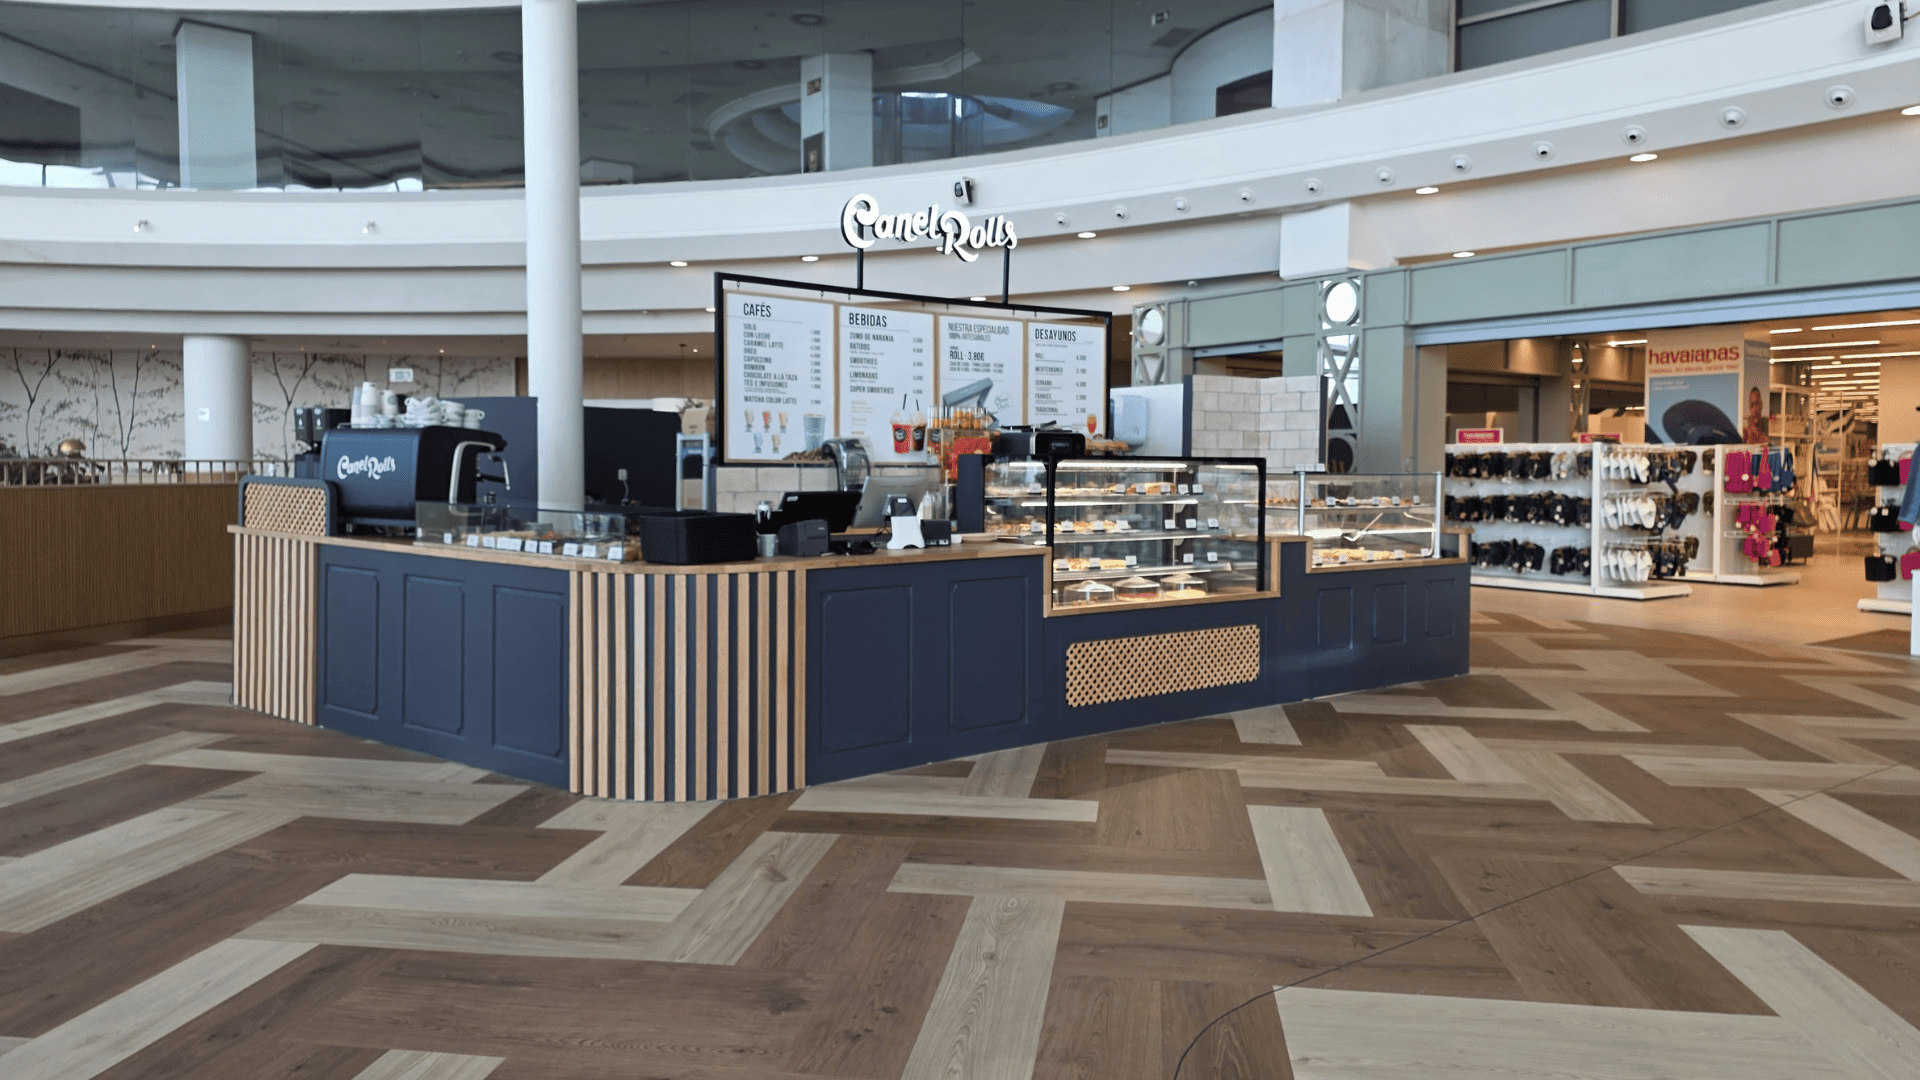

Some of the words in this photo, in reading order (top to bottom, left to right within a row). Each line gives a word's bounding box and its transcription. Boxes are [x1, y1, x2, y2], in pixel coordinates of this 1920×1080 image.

[841, 194, 942, 249] Canel
[936, 211, 1018, 262] Rolls
[743, 302, 772, 317] CAFÉS
[848, 312, 887, 327] BEBIDAS
[948, 322, 972, 332] NUESTRA
[973, 323, 1010, 335] ESPECIALIDAD
[849, 332, 864, 340] ZUMO
[864, 333, 871, 341] DE
[872, 334, 894, 342] NARANJA
[1034, 328, 1077, 342] DESAYUNOS
[768, 341, 784, 349] LATTE
[849, 342, 871, 351] BATIDOS
[949, 350, 964, 361] ROLL
[1648, 346, 1740, 364] havaianas
[849, 357, 878, 366] SMOOTHIES
[849, 371, 878, 379] LIMONADAS
[849, 385, 866, 394] SUPER
[337, 455, 369, 479] Canel
[367, 455, 396, 480] Rolls
